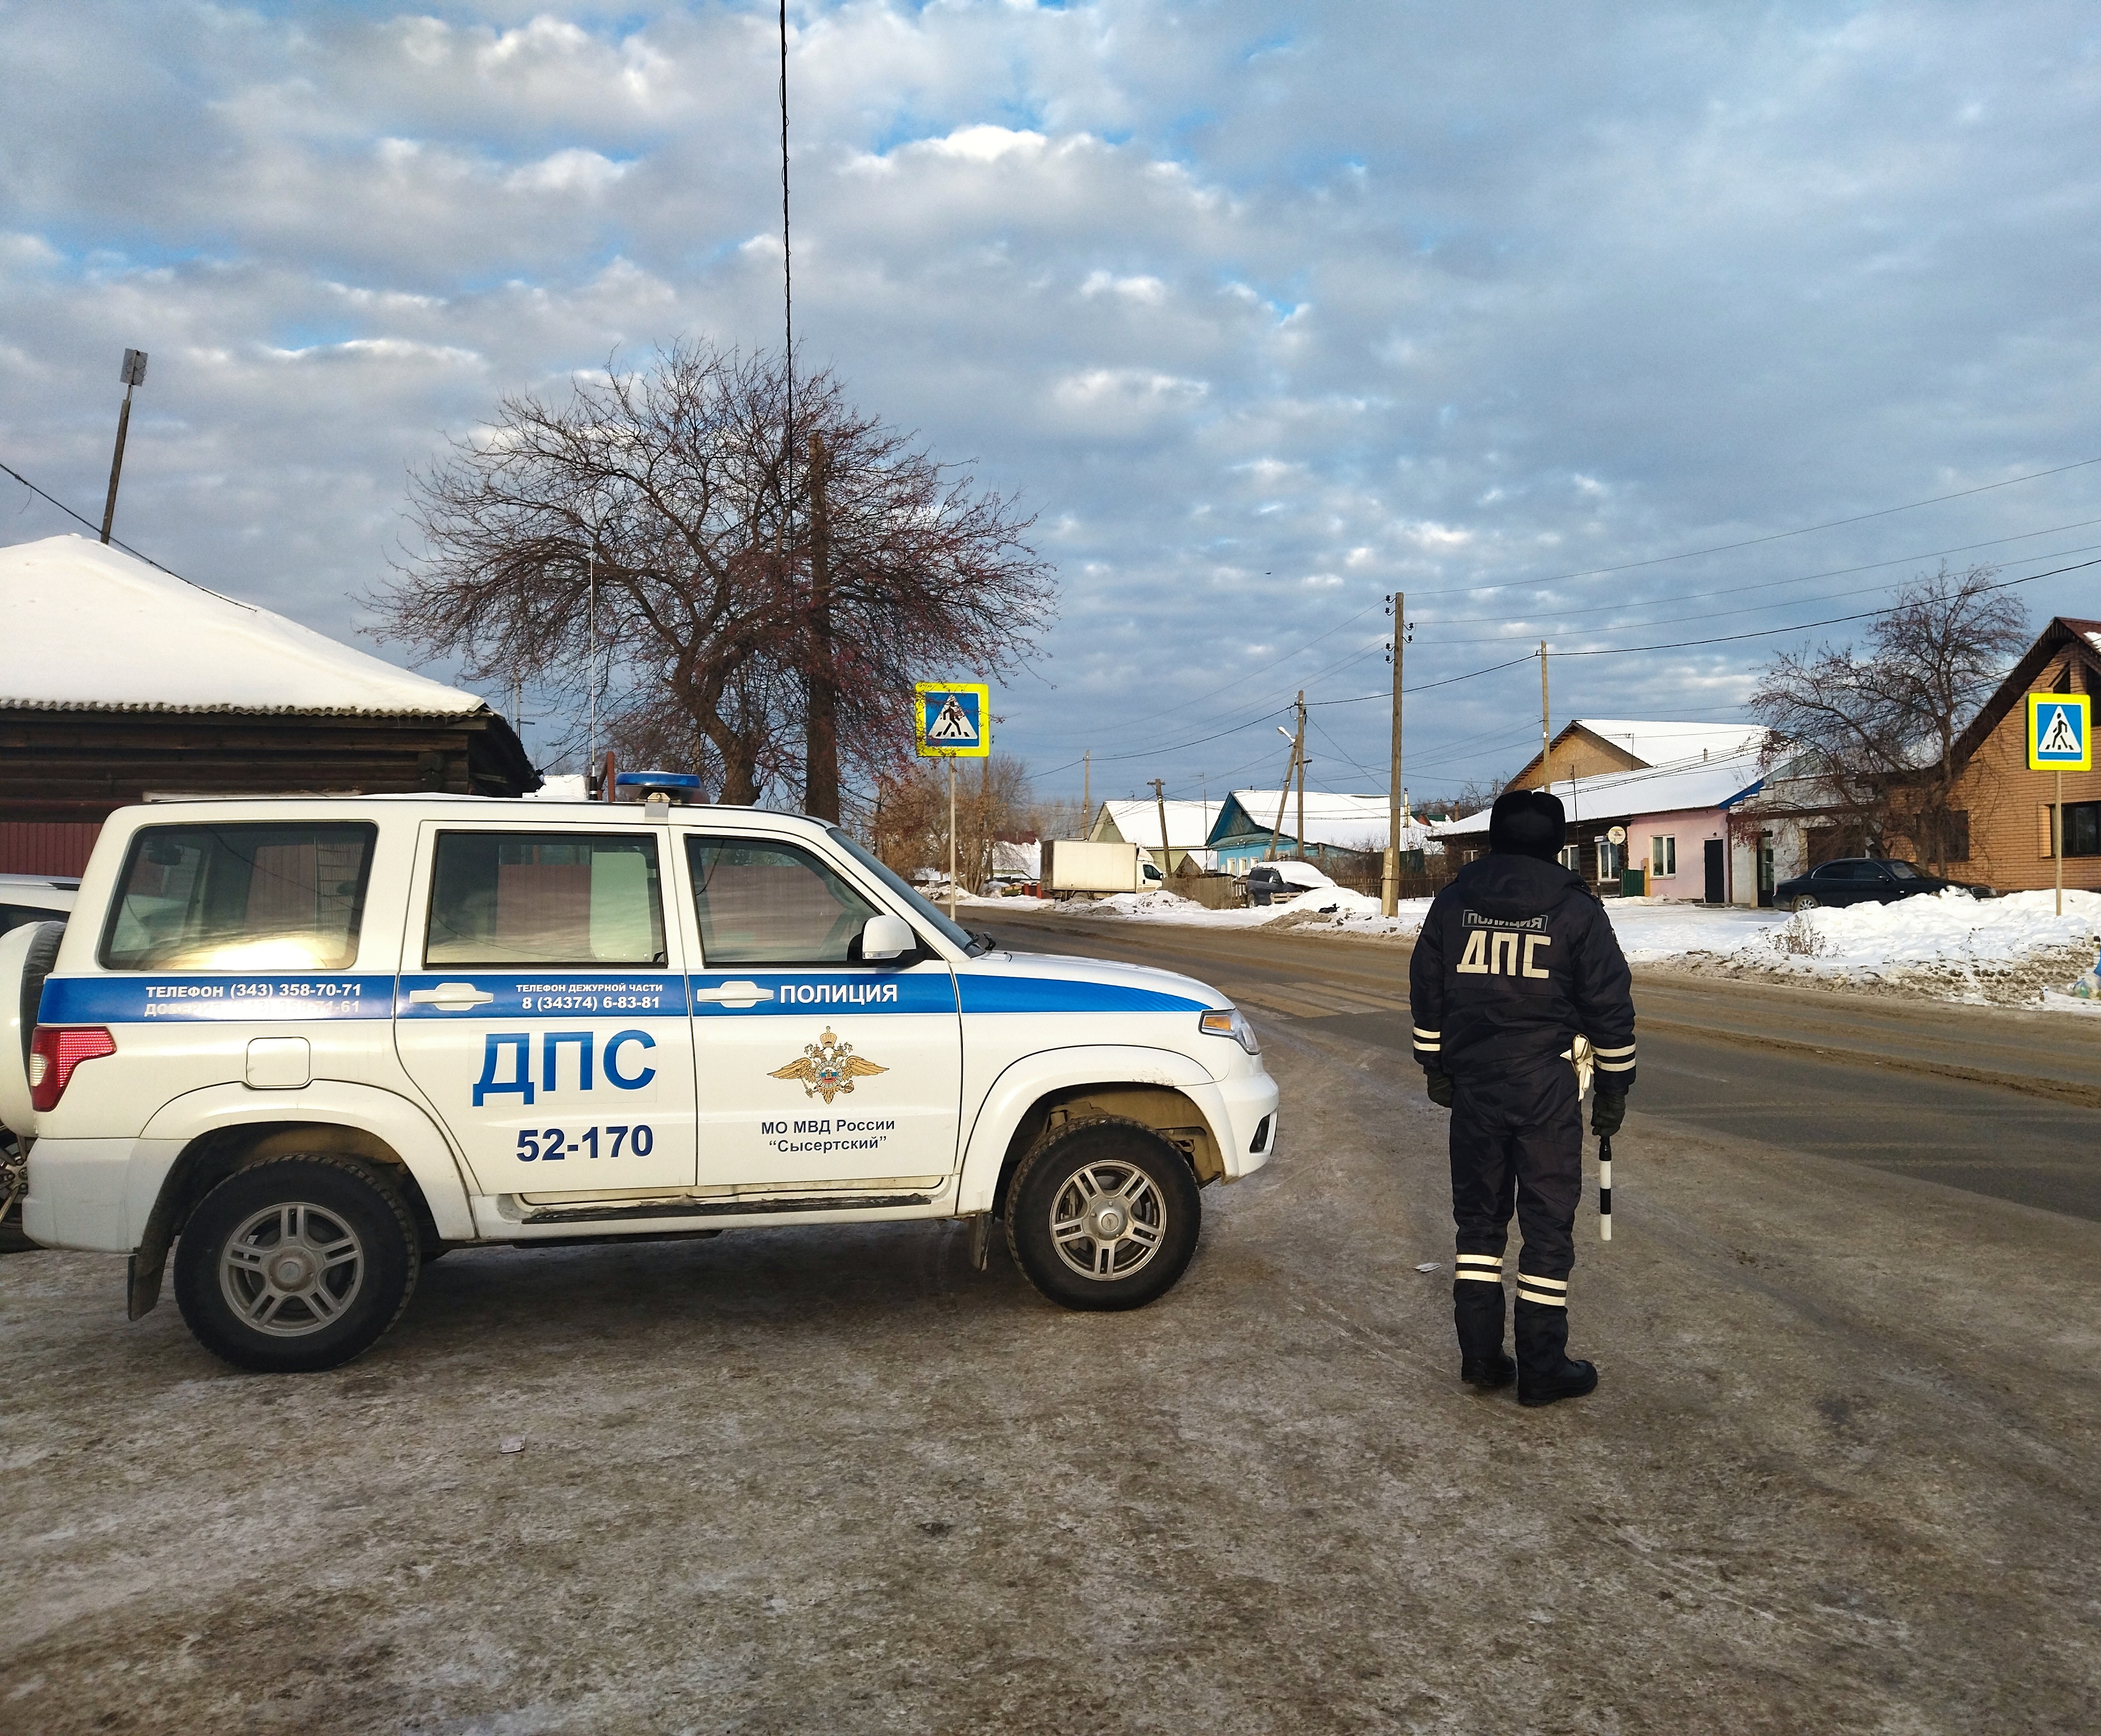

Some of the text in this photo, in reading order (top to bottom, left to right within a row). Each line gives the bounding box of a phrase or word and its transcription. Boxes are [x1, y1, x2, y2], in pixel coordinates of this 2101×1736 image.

[1456, 930, 1551, 979] ДПС
[146, 984, 361, 999] ТЕЛЕФОН (343) 358-70-71
[516, 984, 566, 992] ТЕЛЕФОН
[568, 983, 626, 993] ДЕЖУРНОЙ
[780, 984, 897, 1005] ПОЛИЦИЯ
[522, 996, 660, 1012] 8 (34374) 6-83-81
[472, 1029, 656, 1106] ДПС
[761, 1119, 895, 1135] МО МВД России
[516, 1125, 653, 1162] 52-170
